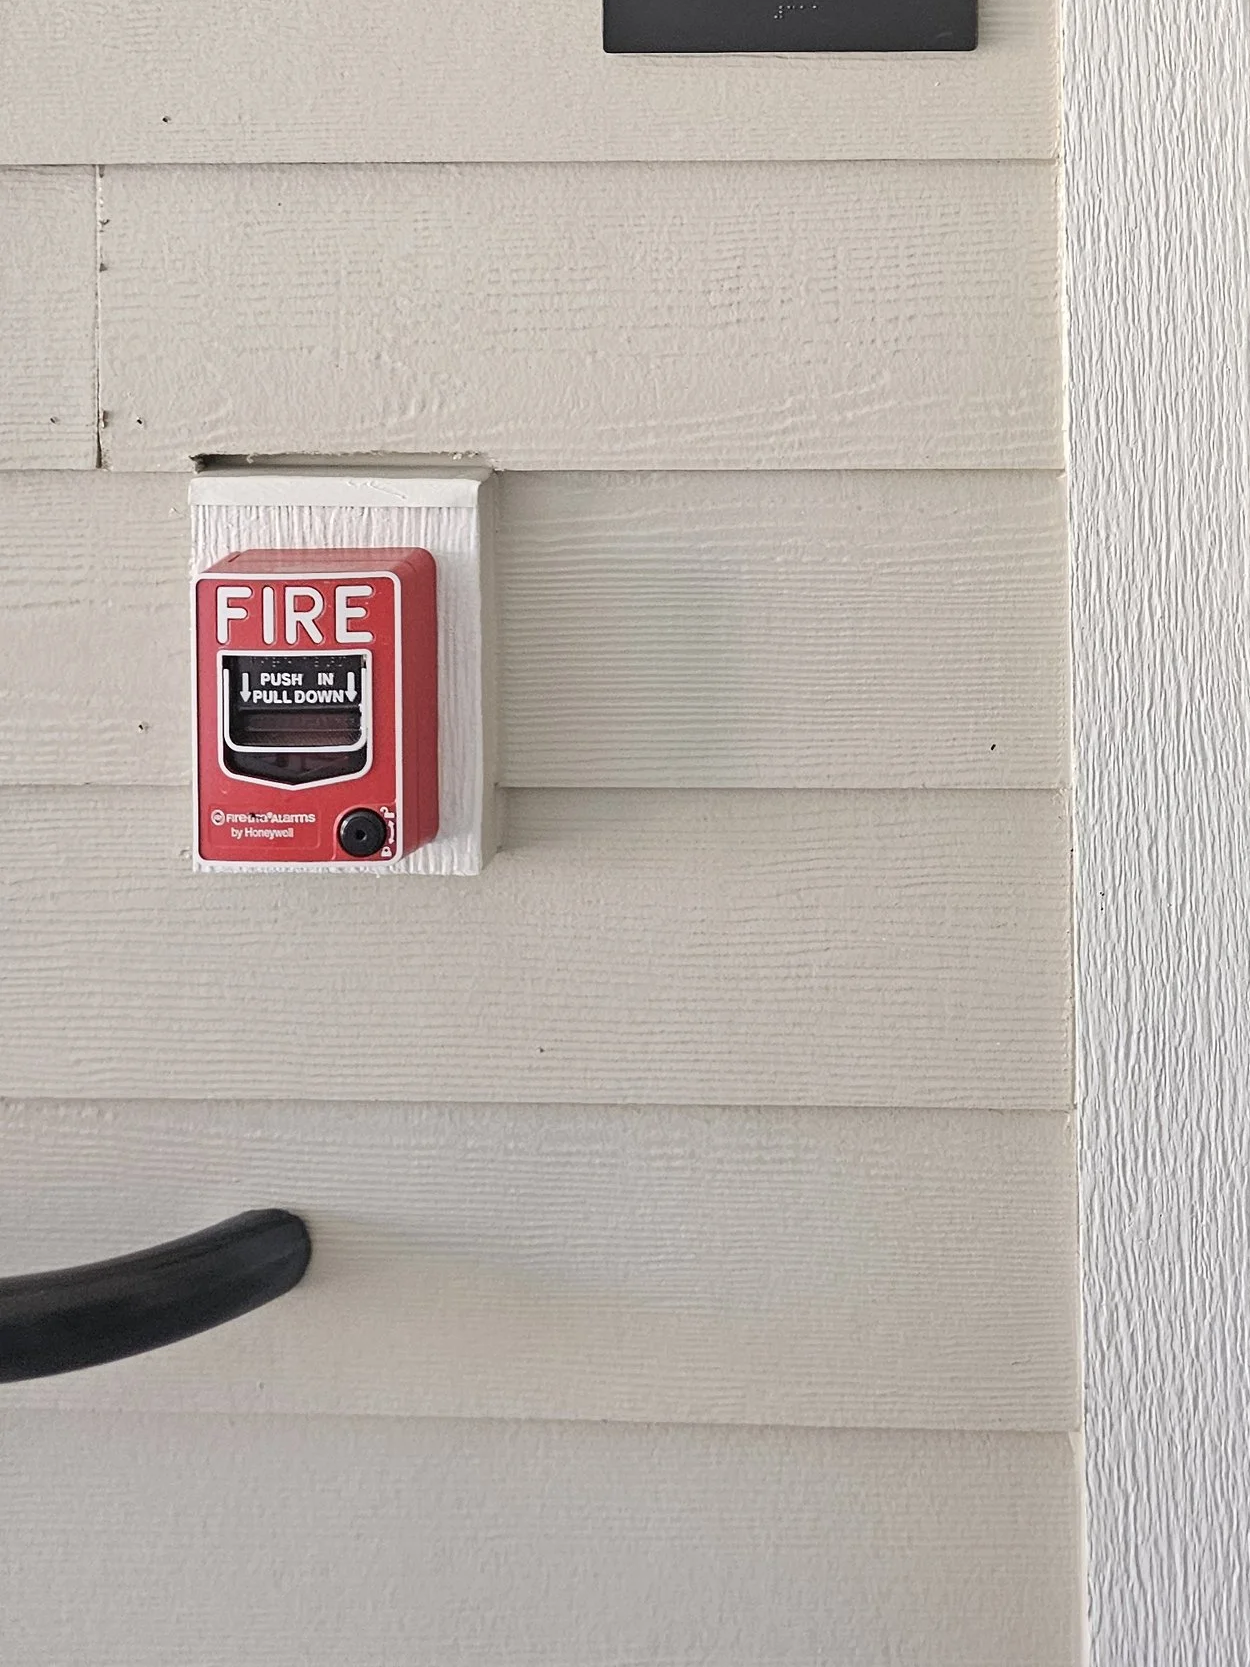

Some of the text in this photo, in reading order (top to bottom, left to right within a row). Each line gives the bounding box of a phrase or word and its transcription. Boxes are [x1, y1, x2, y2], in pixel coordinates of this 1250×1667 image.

[216, 585, 374, 645] FIRE
[260, 672, 334, 686] PUSH IN
[252, 689, 344, 704] PULL DOWN
[230, 827, 294, 840] by Honeywell
